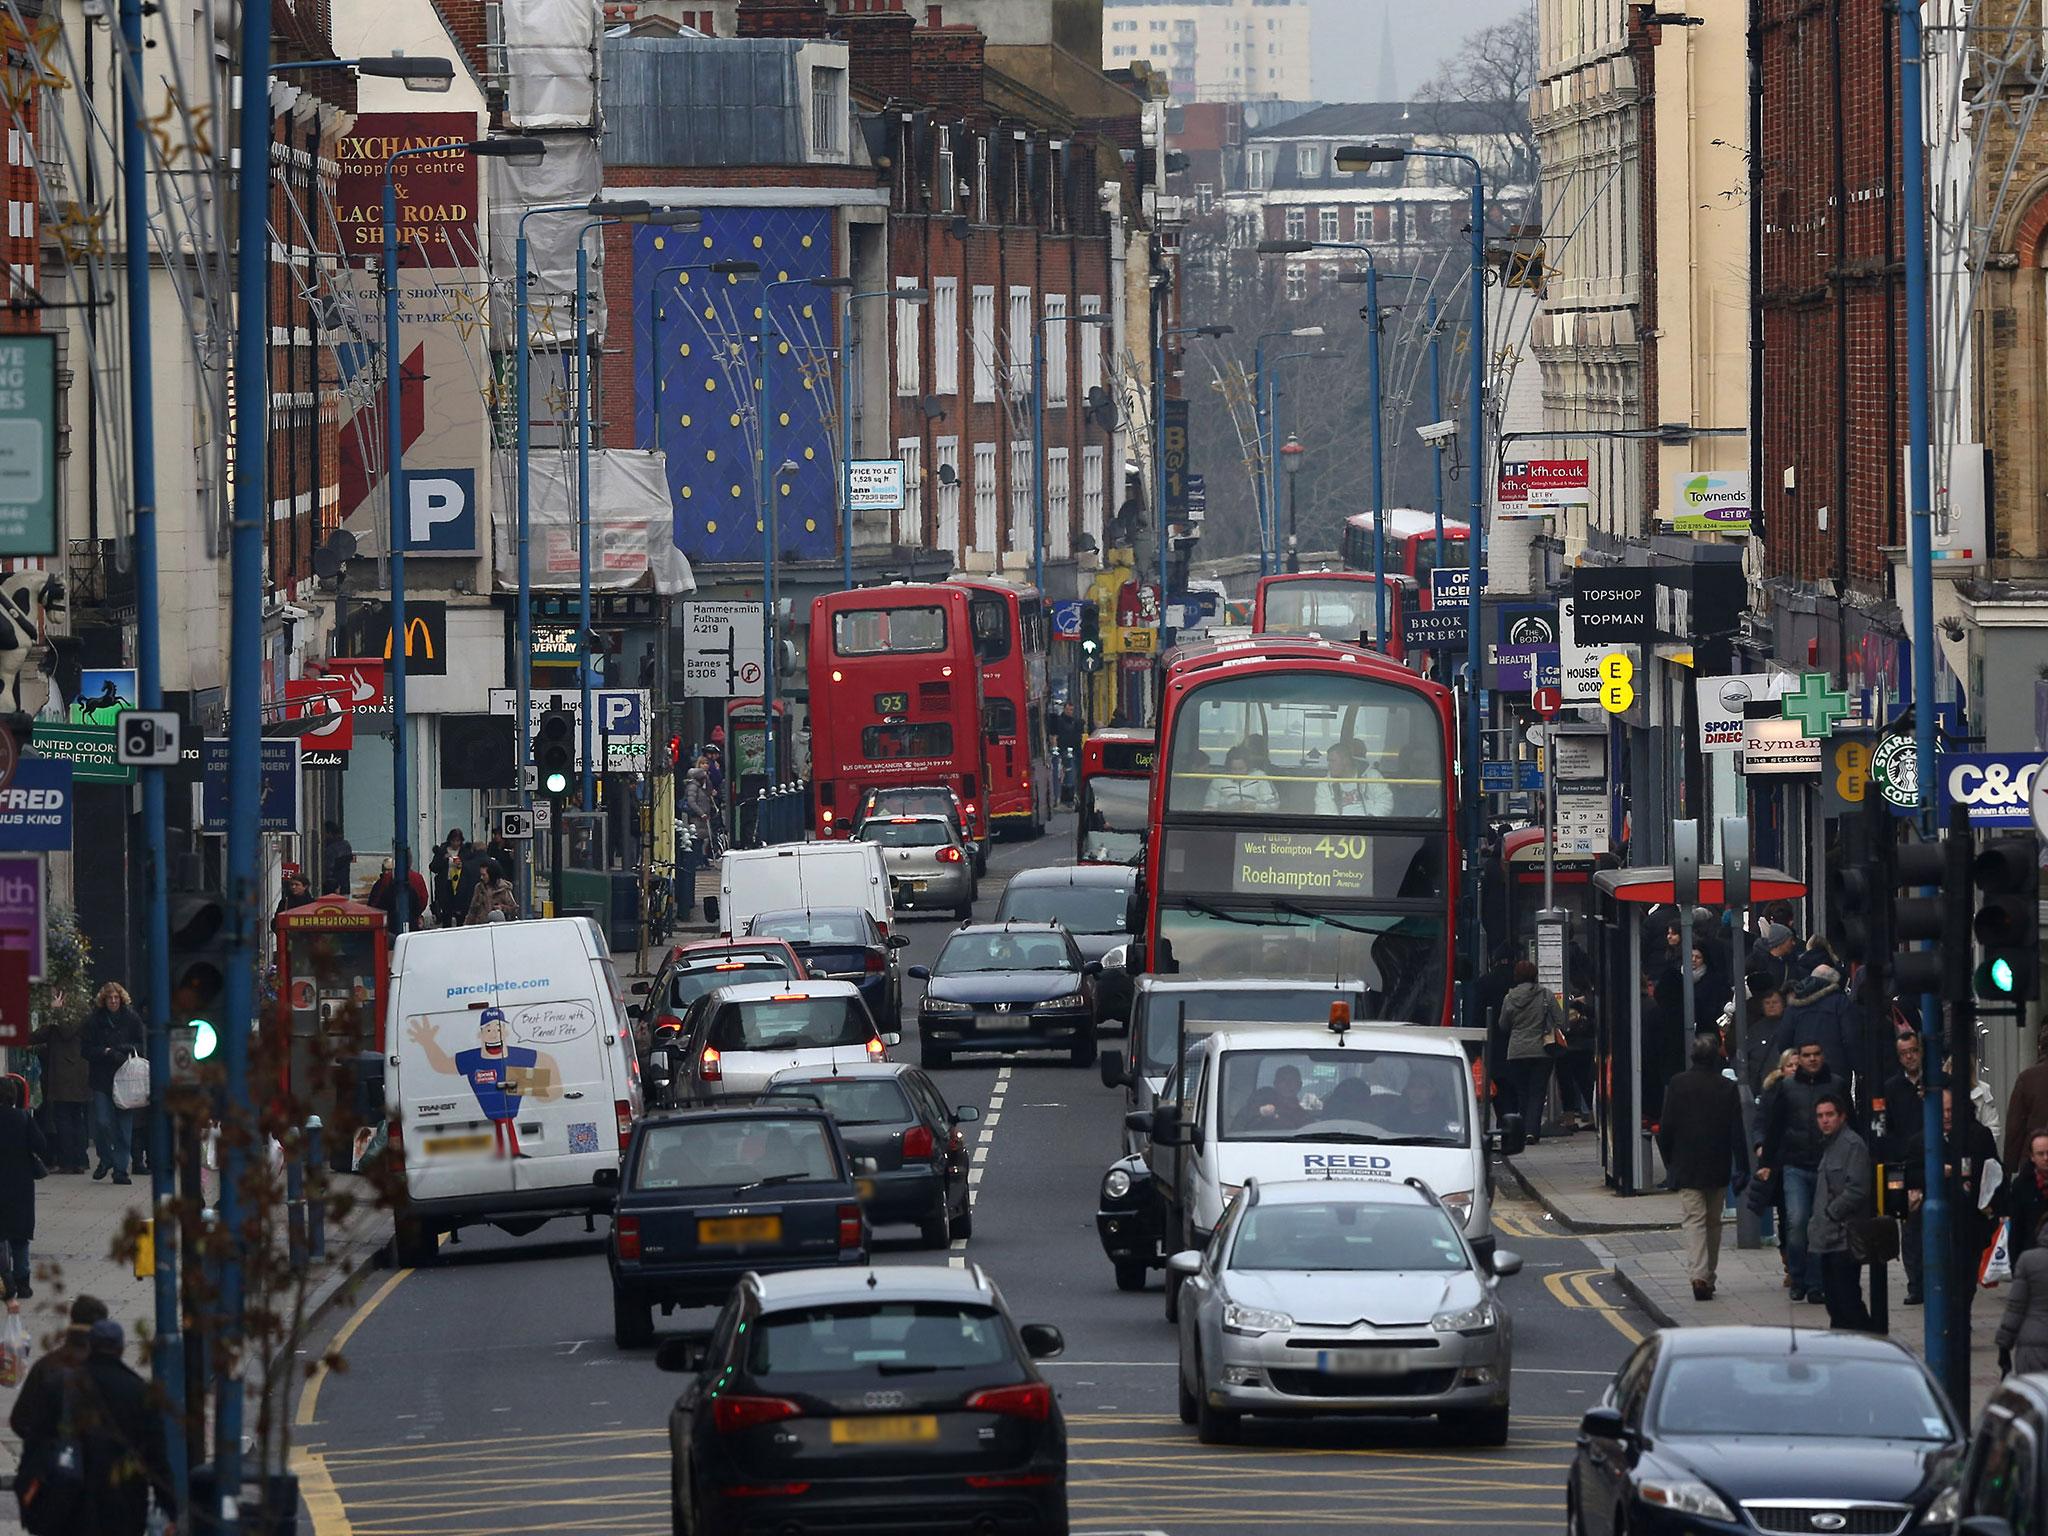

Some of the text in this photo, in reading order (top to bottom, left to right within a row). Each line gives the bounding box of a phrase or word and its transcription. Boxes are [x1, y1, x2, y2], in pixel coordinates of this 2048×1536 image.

[336, 136, 465, 160] EXCHANGE
[338, 162, 465, 177] hopping centre
[394, 182, 409, 199] &
[337, 204, 467, 223] LAC ROAD
[359, 289, 404, 299] GRT
[1531, 465, 1584, 477] kfh.co.uk
[1689, 490, 1747, 502] Townends
[410, 478, 466, 542] P
[1720, 510, 1748, 519] LET BY
[1452, 573, 1470, 584] OF
[1437, 585, 1488, 597] LICEC
[1582, 589, 1643, 601] TOPSHOP
[1436, 599, 1458, 607] OPEN
[693, 605, 760, 614] Hammersmith
[693, 615, 729, 623] Fulham
[1411, 616, 1462, 629] BROOK
[1580, 613, 1645, 626] TOPMAN
[1406, 629, 1467, 643] STREET
[1519, 635, 1545, 644] BODY
[687, 659, 721, 668] Barnes
[1499, 655, 1531, 665] HEALTH
[1567, 668, 1600, 679] HOUSE
[1577, 682, 1603, 693] GOOD
[531, 700, 583, 712] Excnge
[881, 696, 902, 711] 93
[605, 697, 633, 731] P
[1704, 720, 1744, 733] SPORT
[1705, 732, 1743, 744] DIREC
[32, 739, 118, 753] UNITED COLOR
[1747, 737, 1822, 752] Ryman
[301, 751, 342, 765] Clarks
[1884, 784, 1919, 804] COFF
[2006, 805, 2029, 815] Glouc
[26, 814, 62, 825] KING
[1244, 835, 1367, 860] West Brompton 430
[1242, 865, 1331, 890] Roehampton
[294, 916, 366, 927] TELEPHONE
[446, 976, 550, 998] parcelpete.com
[522, 1009, 585, 1024] Best Prices with
[532, 1023, 577, 1038] Parcel Pete
[417, 1102, 457, 1113] TRANSIT
[1303, 1154, 1392, 1169] REED
